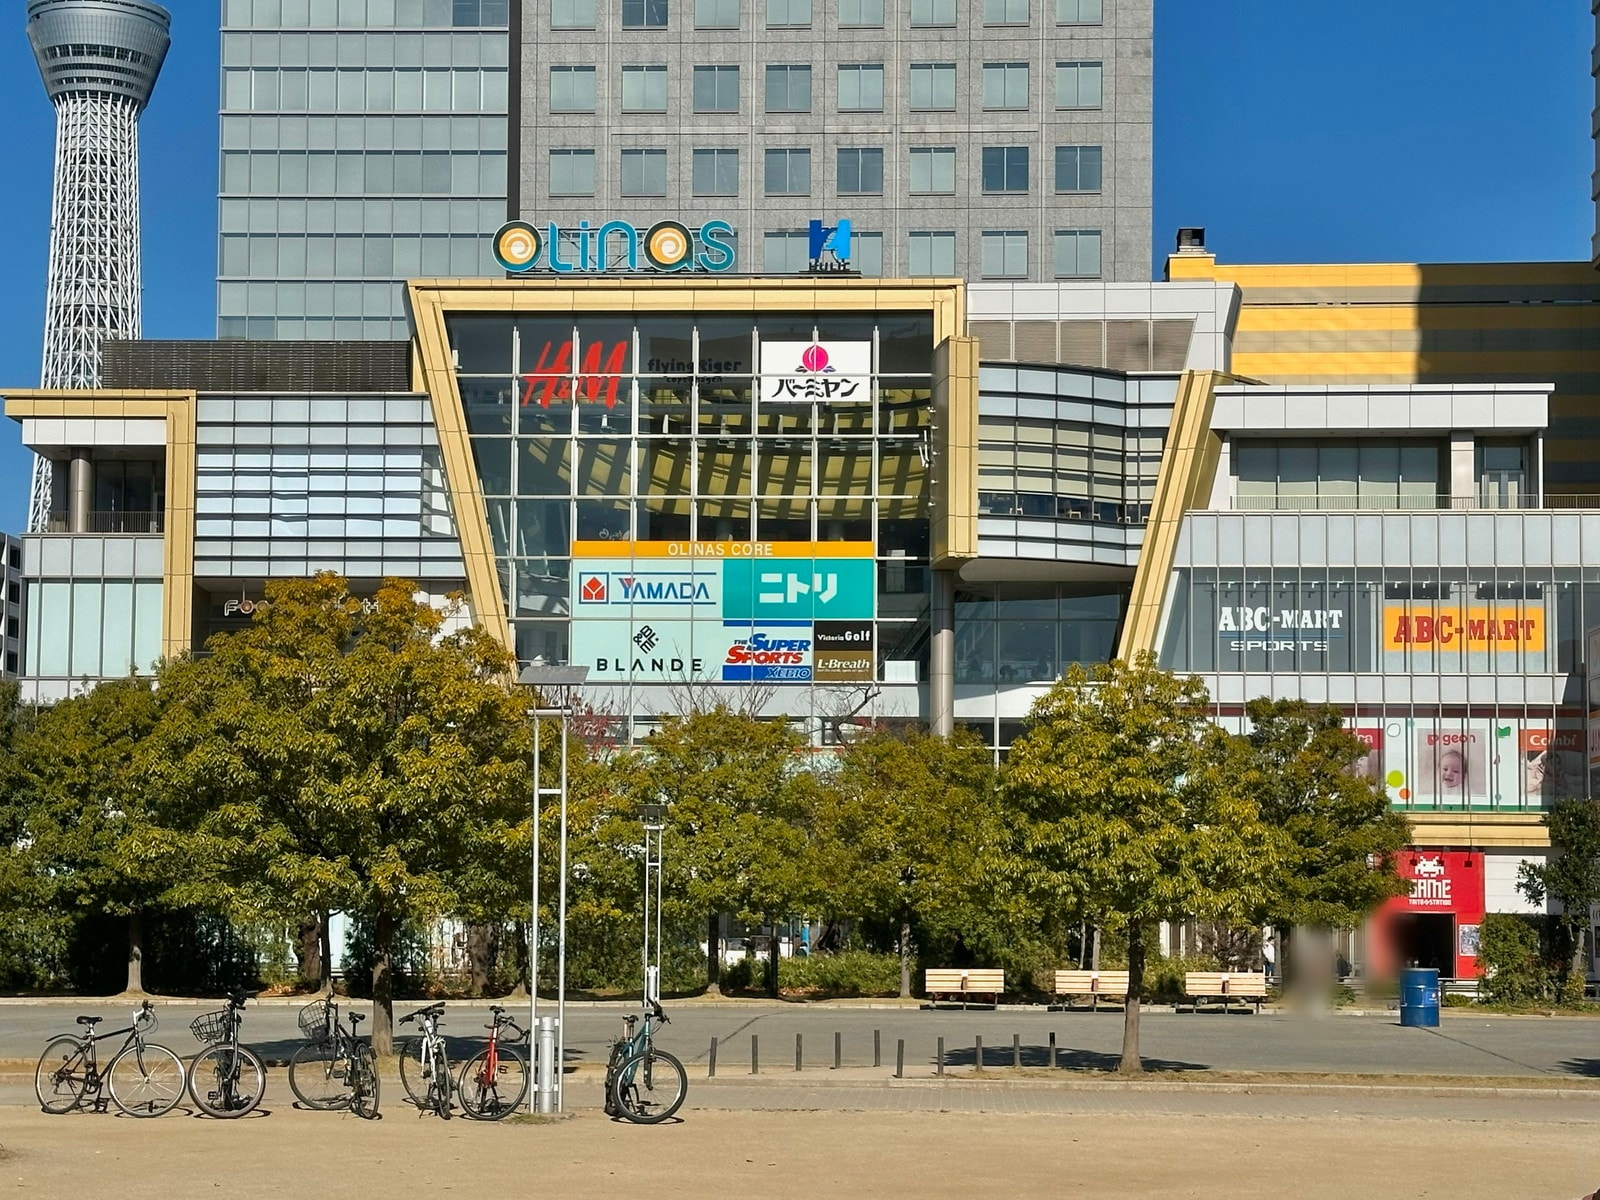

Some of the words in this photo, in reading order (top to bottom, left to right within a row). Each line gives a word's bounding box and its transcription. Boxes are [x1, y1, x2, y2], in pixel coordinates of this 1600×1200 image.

[521, 340, 627, 409] H&M
[771, 378, 859, 398] バーミヤン
[667, 543, 725, 557] OLINAS
[730, 543, 774, 557] CORE
[618, 578, 711, 600] YAMADA
[759, 572, 837, 603] ニトリ
[1218, 606, 1343, 631] ABC-MART
[1393, 615, 1535, 643] ABC-MART
[746, 633, 811, 651] SUPER
[1230, 641, 1328, 651] SPORTS
[726, 645, 803, 664] SPORTS
[597, 658, 702, 672] BLANDE
[765, 666, 811, 679] XEBIO
[1427, 735, 1476, 746] pgeon
[1408, 879, 1451, 898] GAME
